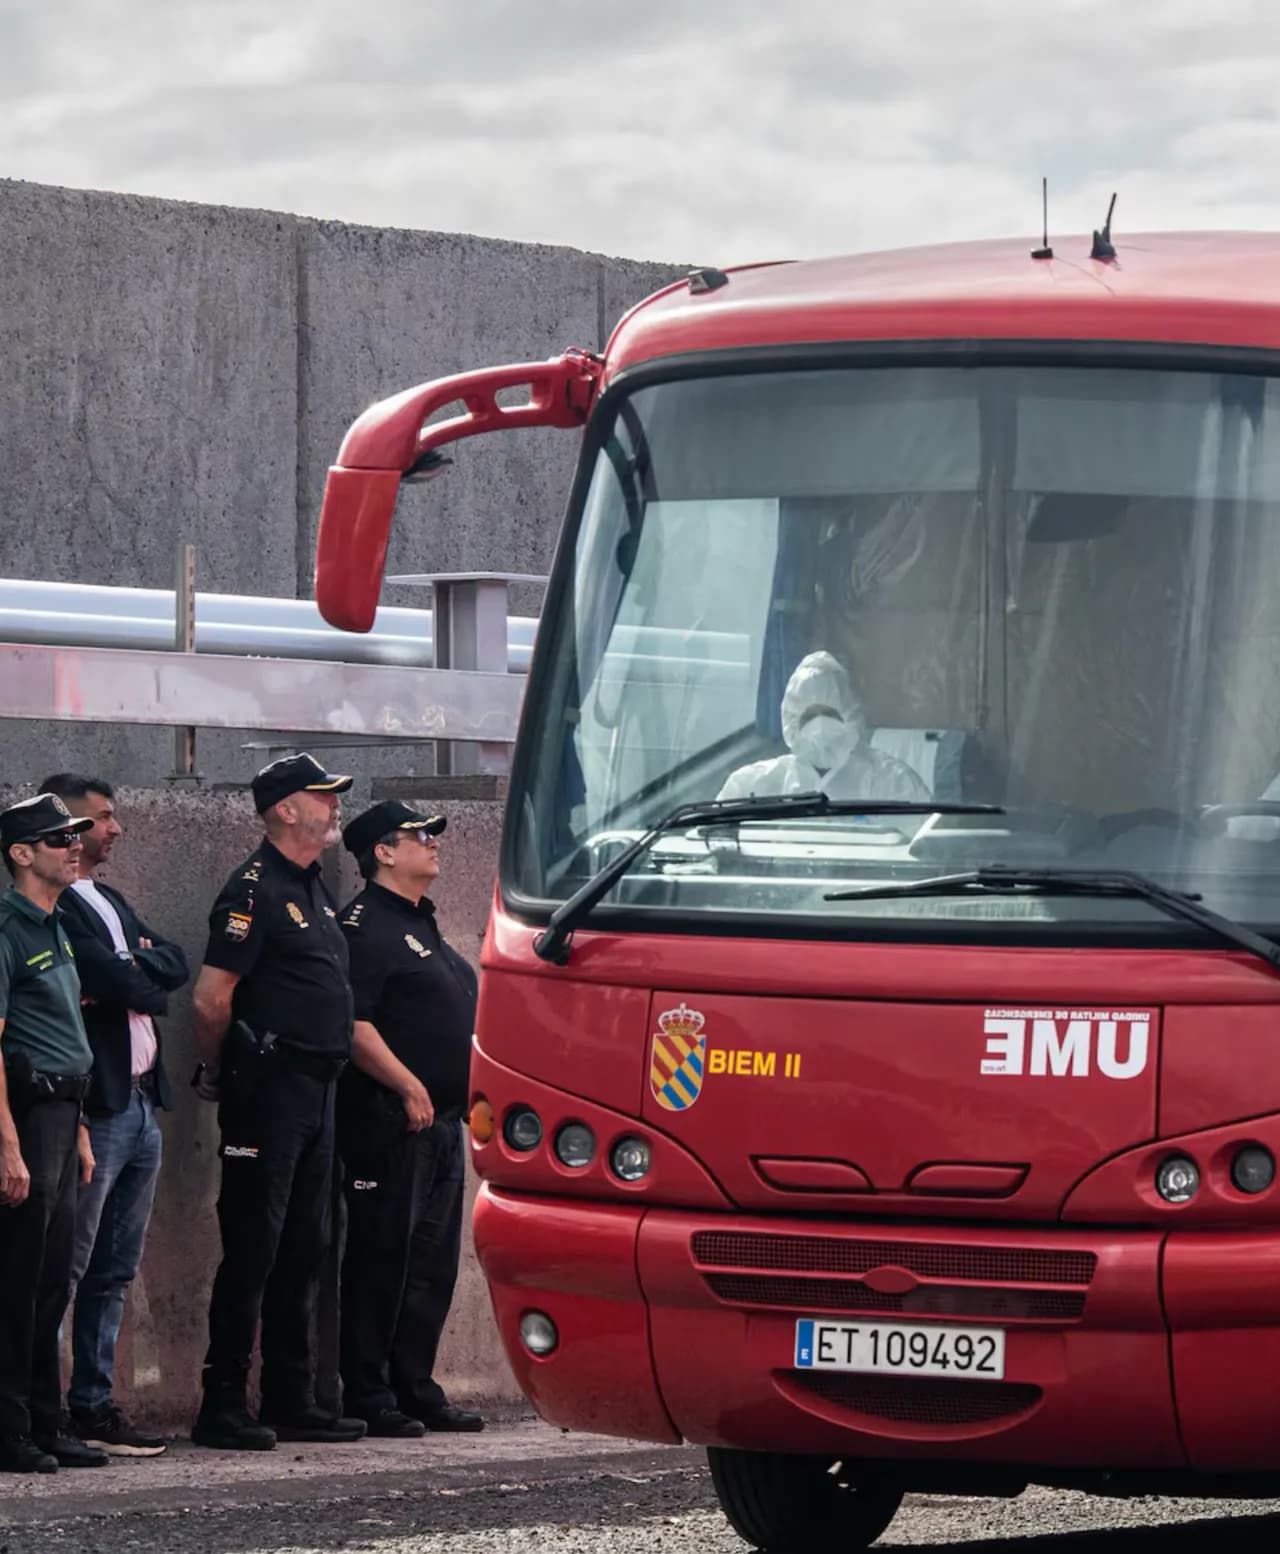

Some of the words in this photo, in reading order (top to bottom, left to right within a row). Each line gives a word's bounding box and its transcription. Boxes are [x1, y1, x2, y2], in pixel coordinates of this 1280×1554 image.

[708, 1048, 777, 1077] BIEM
[784, 1053, 802, 1078] II
[801, 1348, 809, 1360] E
